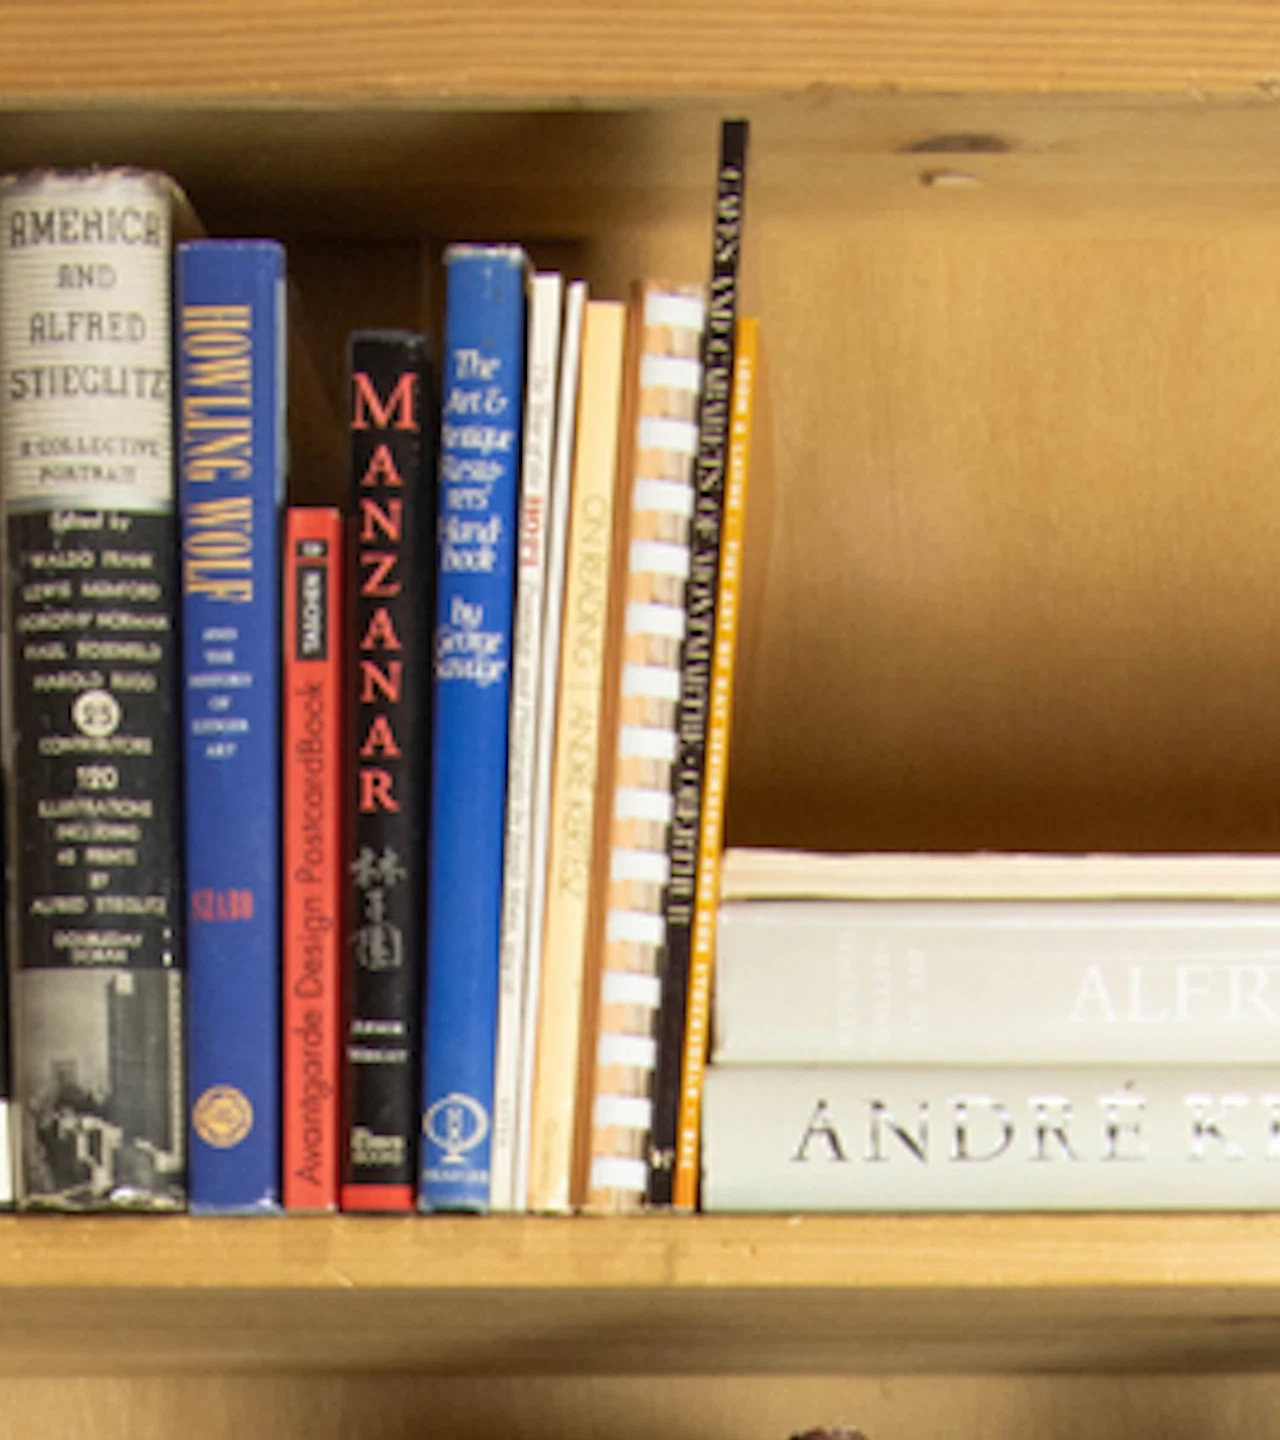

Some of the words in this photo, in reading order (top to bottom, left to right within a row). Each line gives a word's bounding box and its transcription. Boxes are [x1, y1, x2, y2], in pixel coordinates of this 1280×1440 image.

[9, 211, 161, 247] AMERICA
[57, 264, 116, 290] AND
[29, 311, 146, 343] ALFRED
[10, 368, 167, 399] STIEGLITZ
[183, 304, 252, 484] HOWLING
[184, 496, 252, 602] WOLF
[349, 371, 421, 814] MANZANAR
[298, 680, 331, 886] PostcardBook
[294, 897, 331, 1001] Design
[294, 1010, 331, 1189] Avantgarde
[791, 1082, 1150, 1166] ANDRÉ
